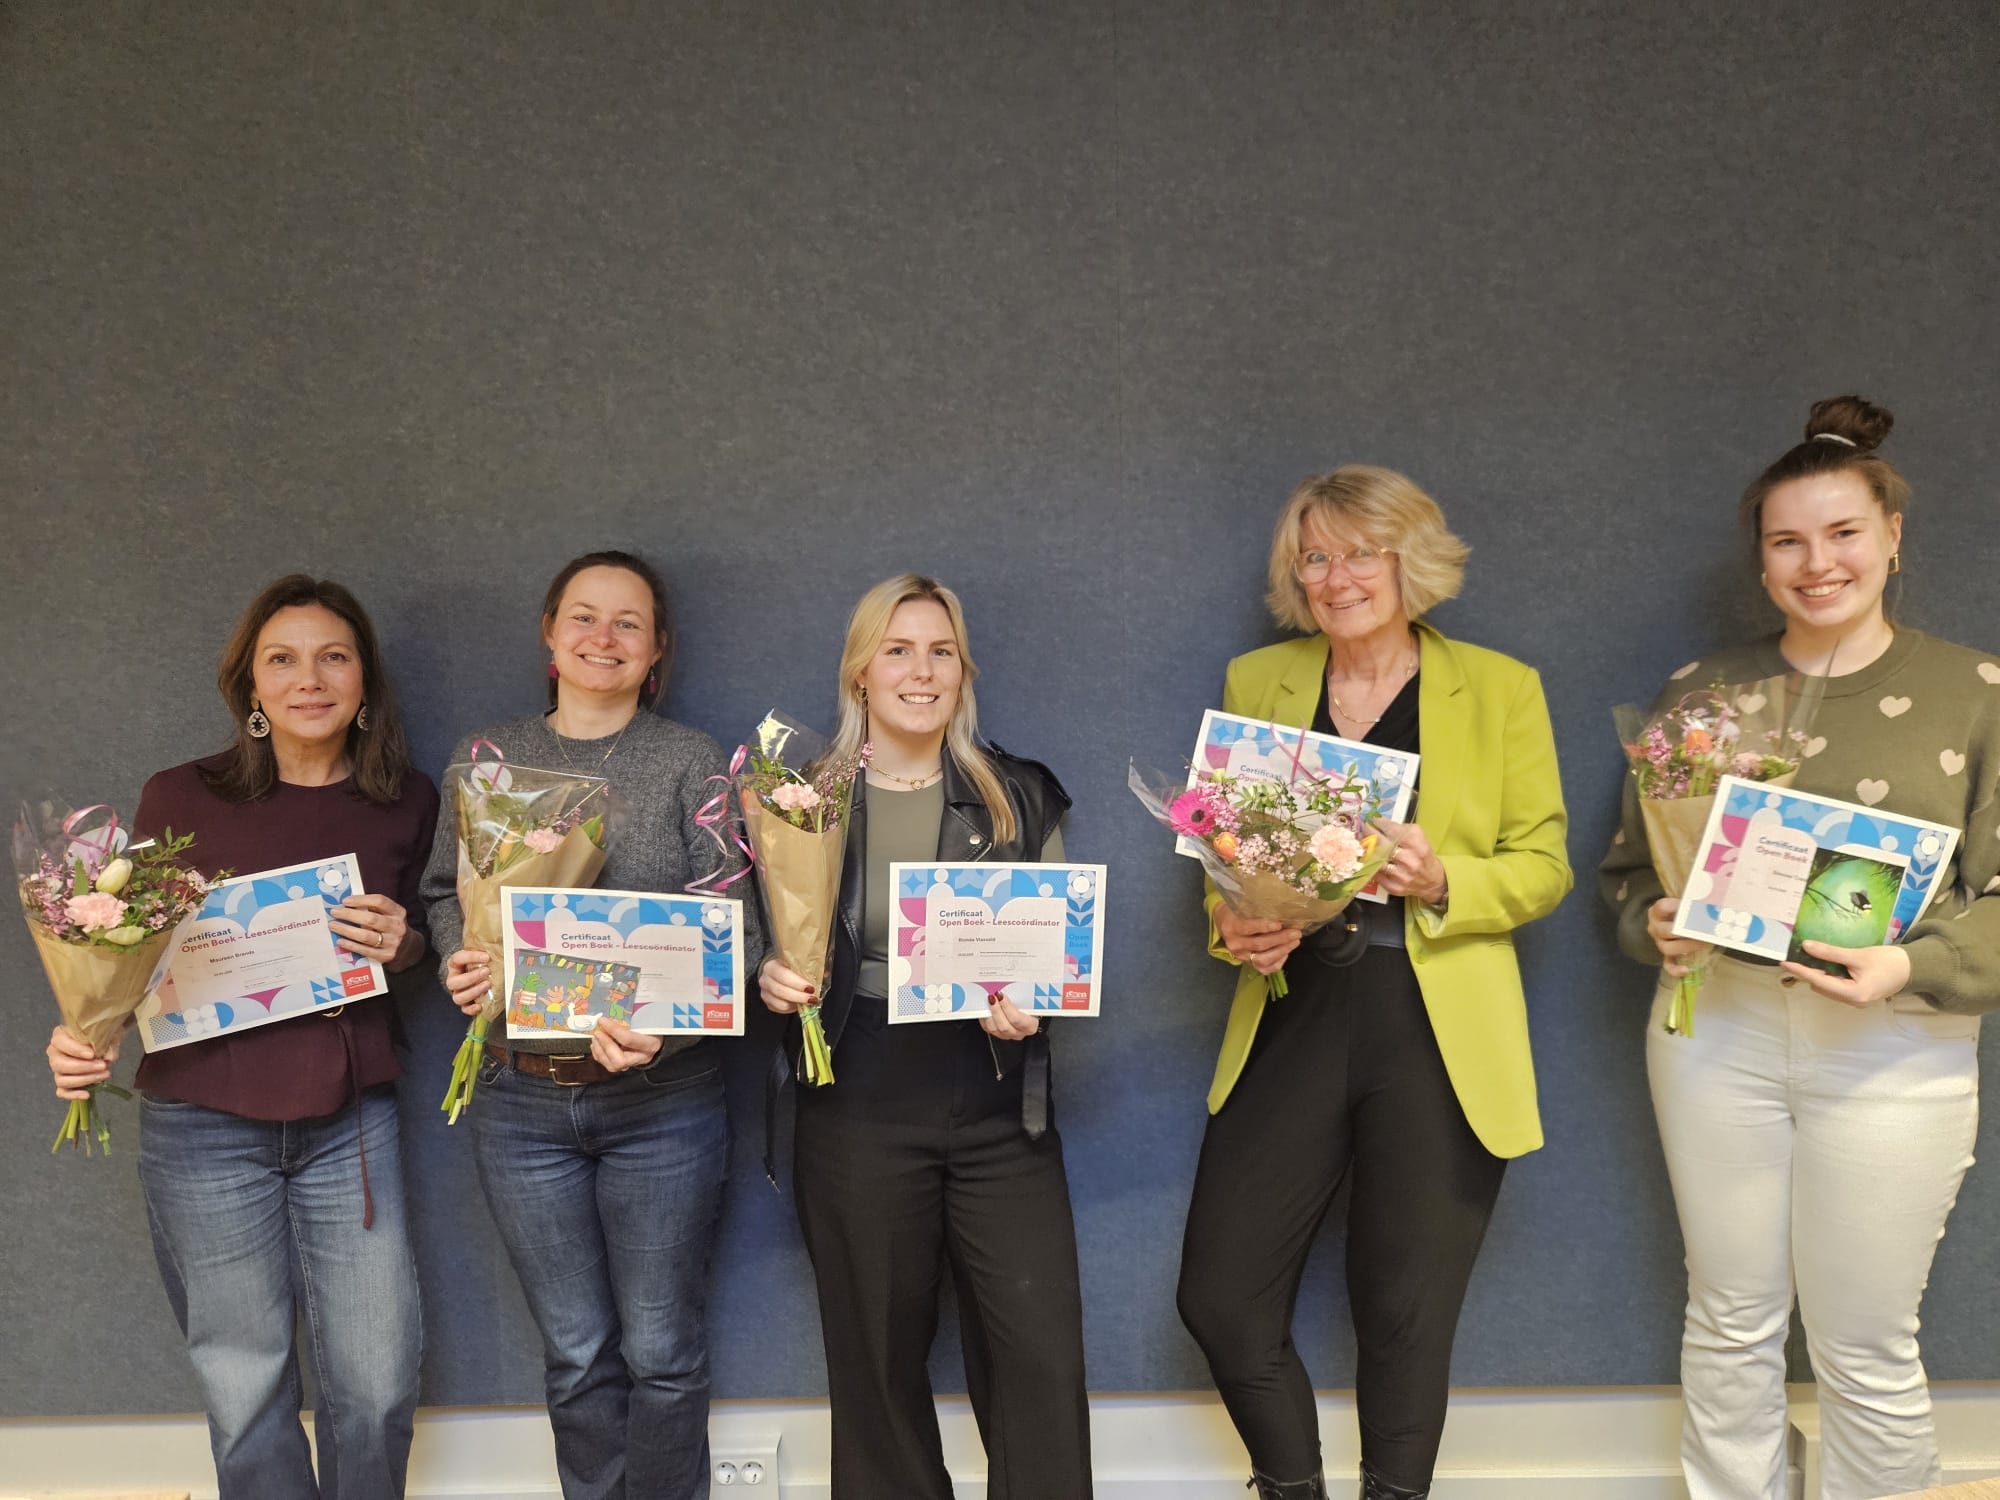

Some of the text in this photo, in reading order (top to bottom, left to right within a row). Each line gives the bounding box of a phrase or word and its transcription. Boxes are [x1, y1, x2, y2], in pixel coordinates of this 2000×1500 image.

[939, 909, 983, 917] Certificaat
[939, 919, 962, 929] Open
[963, 918, 985, 926] Boek
[992, 918, 1060, 927] Leescoördinator
[181, 942, 210, 953] Open
[211, 935, 236, 947] Boek
[244, 918, 321, 939] Leescoördinator
[561, 933, 611, 941] Certificaat
[561, 941, 588, 951] Open
[590, 941, 613, 949] Boek
[622, 942, 697, 952] Leescoördinator
